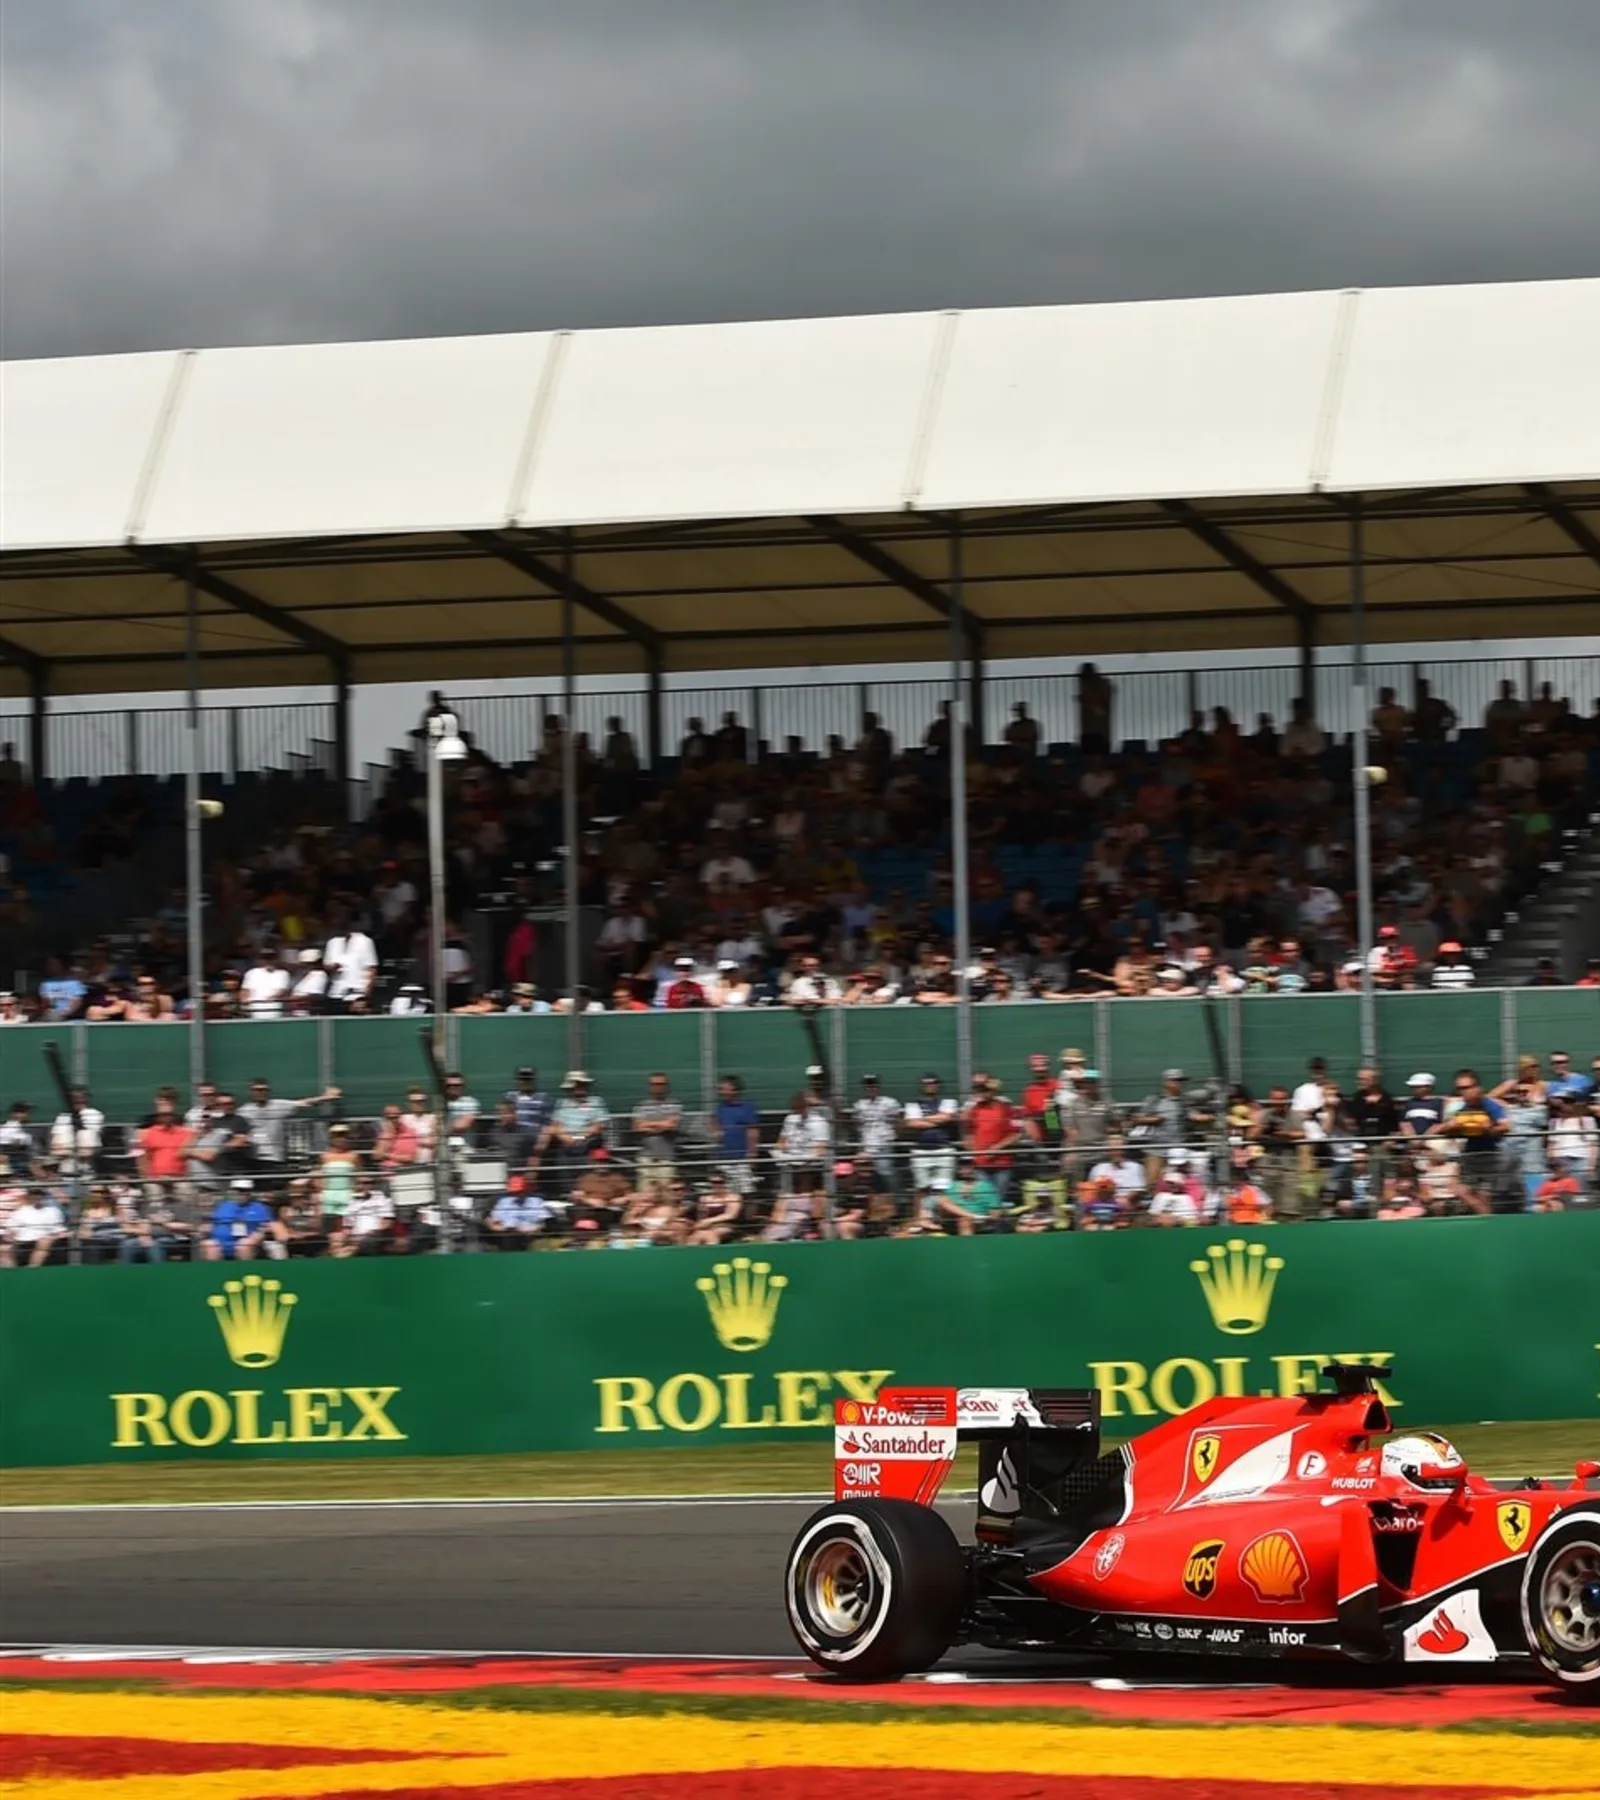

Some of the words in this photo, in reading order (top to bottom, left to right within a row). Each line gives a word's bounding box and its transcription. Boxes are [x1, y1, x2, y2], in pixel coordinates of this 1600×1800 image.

[110, 1386, 408, 1447] ROLEX
[862, 1431, 945, 1454] Santander
[1331, 1478, 1376, 1489] HUBLOT
[1268, 1627, 1307, 1645] infor
